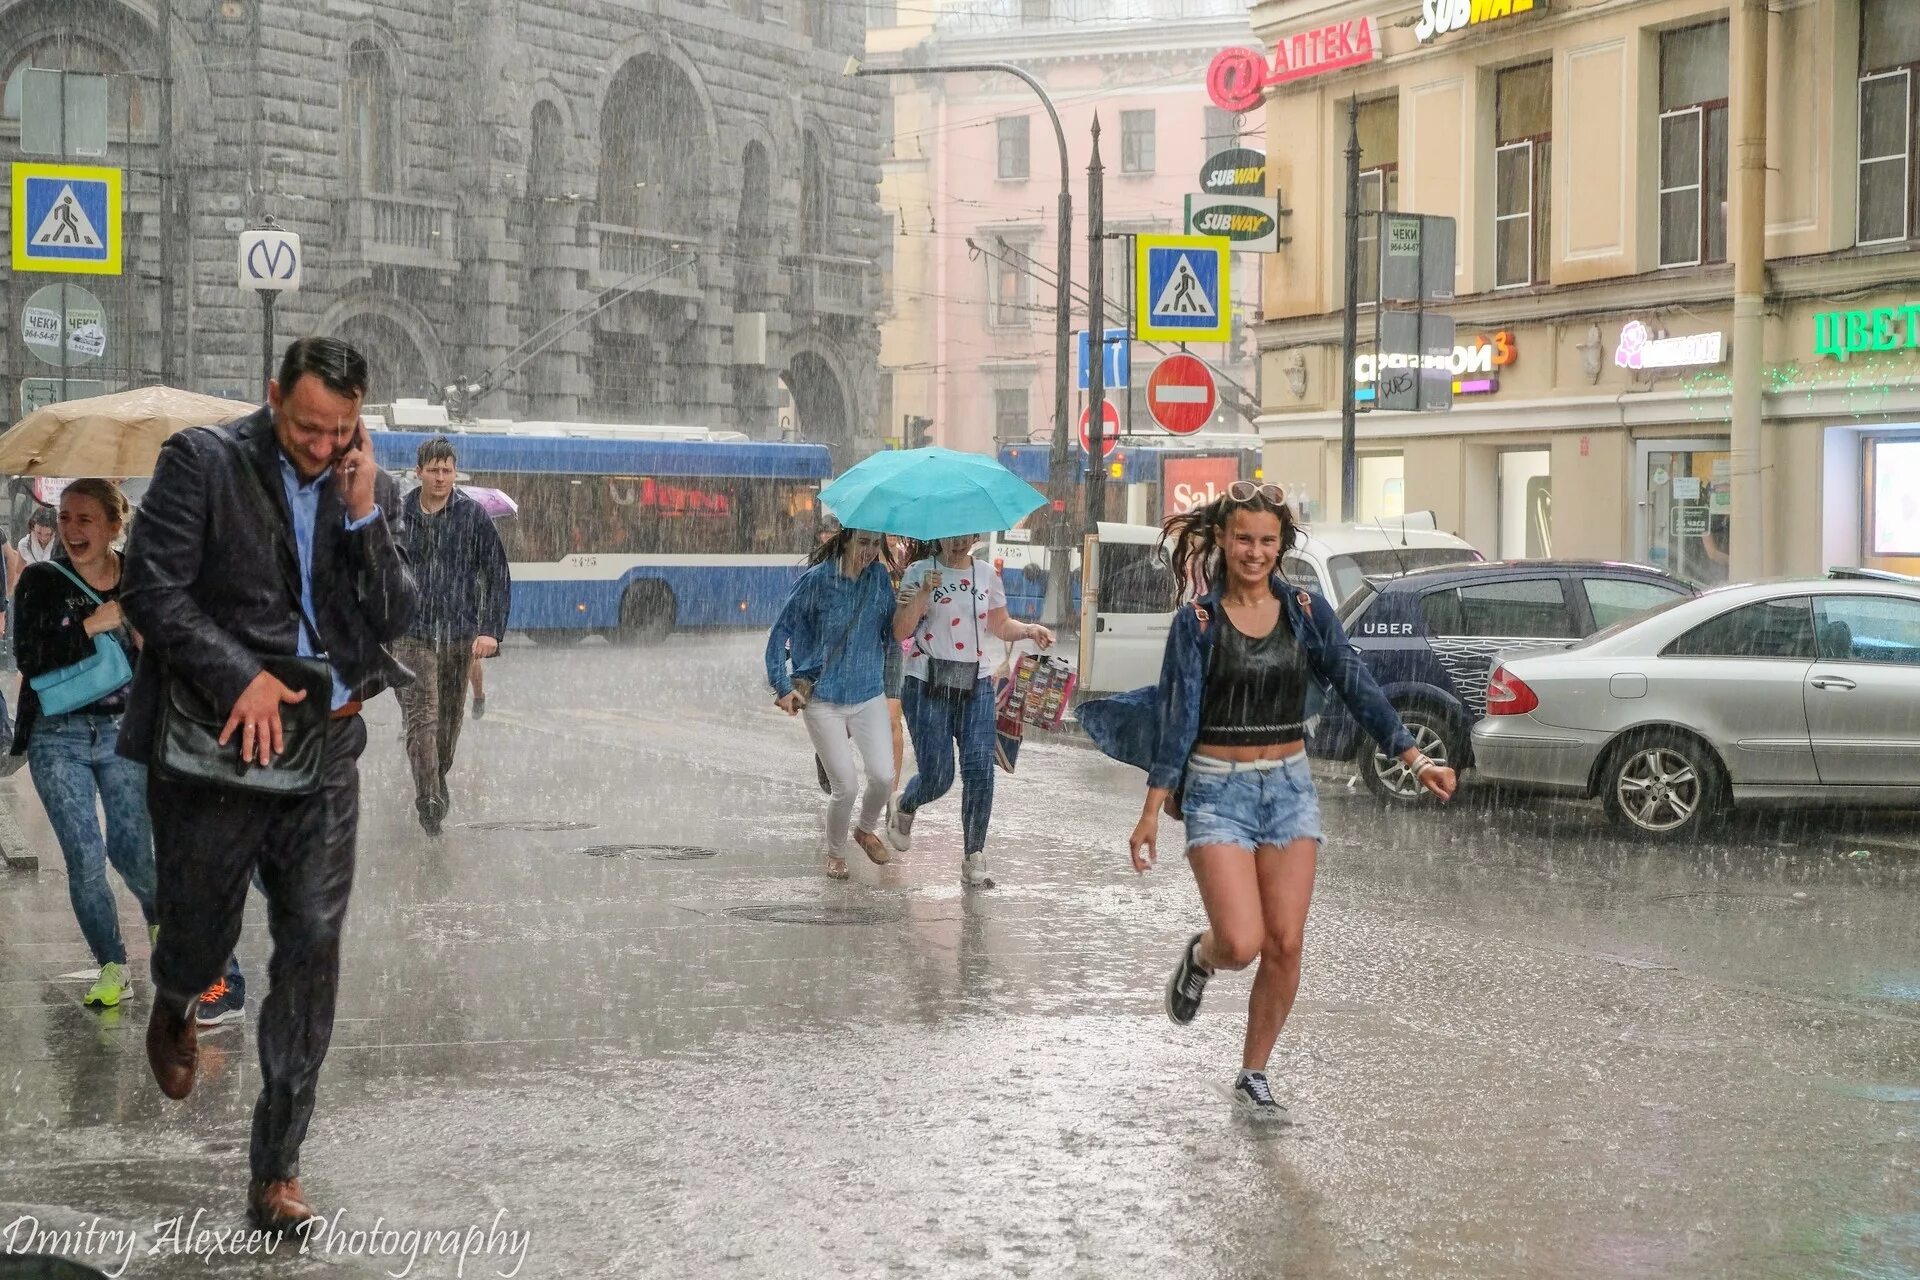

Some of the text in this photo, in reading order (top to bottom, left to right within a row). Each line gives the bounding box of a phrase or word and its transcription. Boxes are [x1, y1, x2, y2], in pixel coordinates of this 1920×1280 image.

[1414, 0, 1534, 43] SUBW
[1275, 16, 1373, 73] АПТЕКА
[1206, 167, 1265, 187] SUBWAY
[1200, 213, 1268, 232] SUBWAY
[1392, 229, 1417, 240] ЧЕКИ
[30, 316, 58, 330] ЧЕКИ
[1364, 623, 1413, 635] UBER
